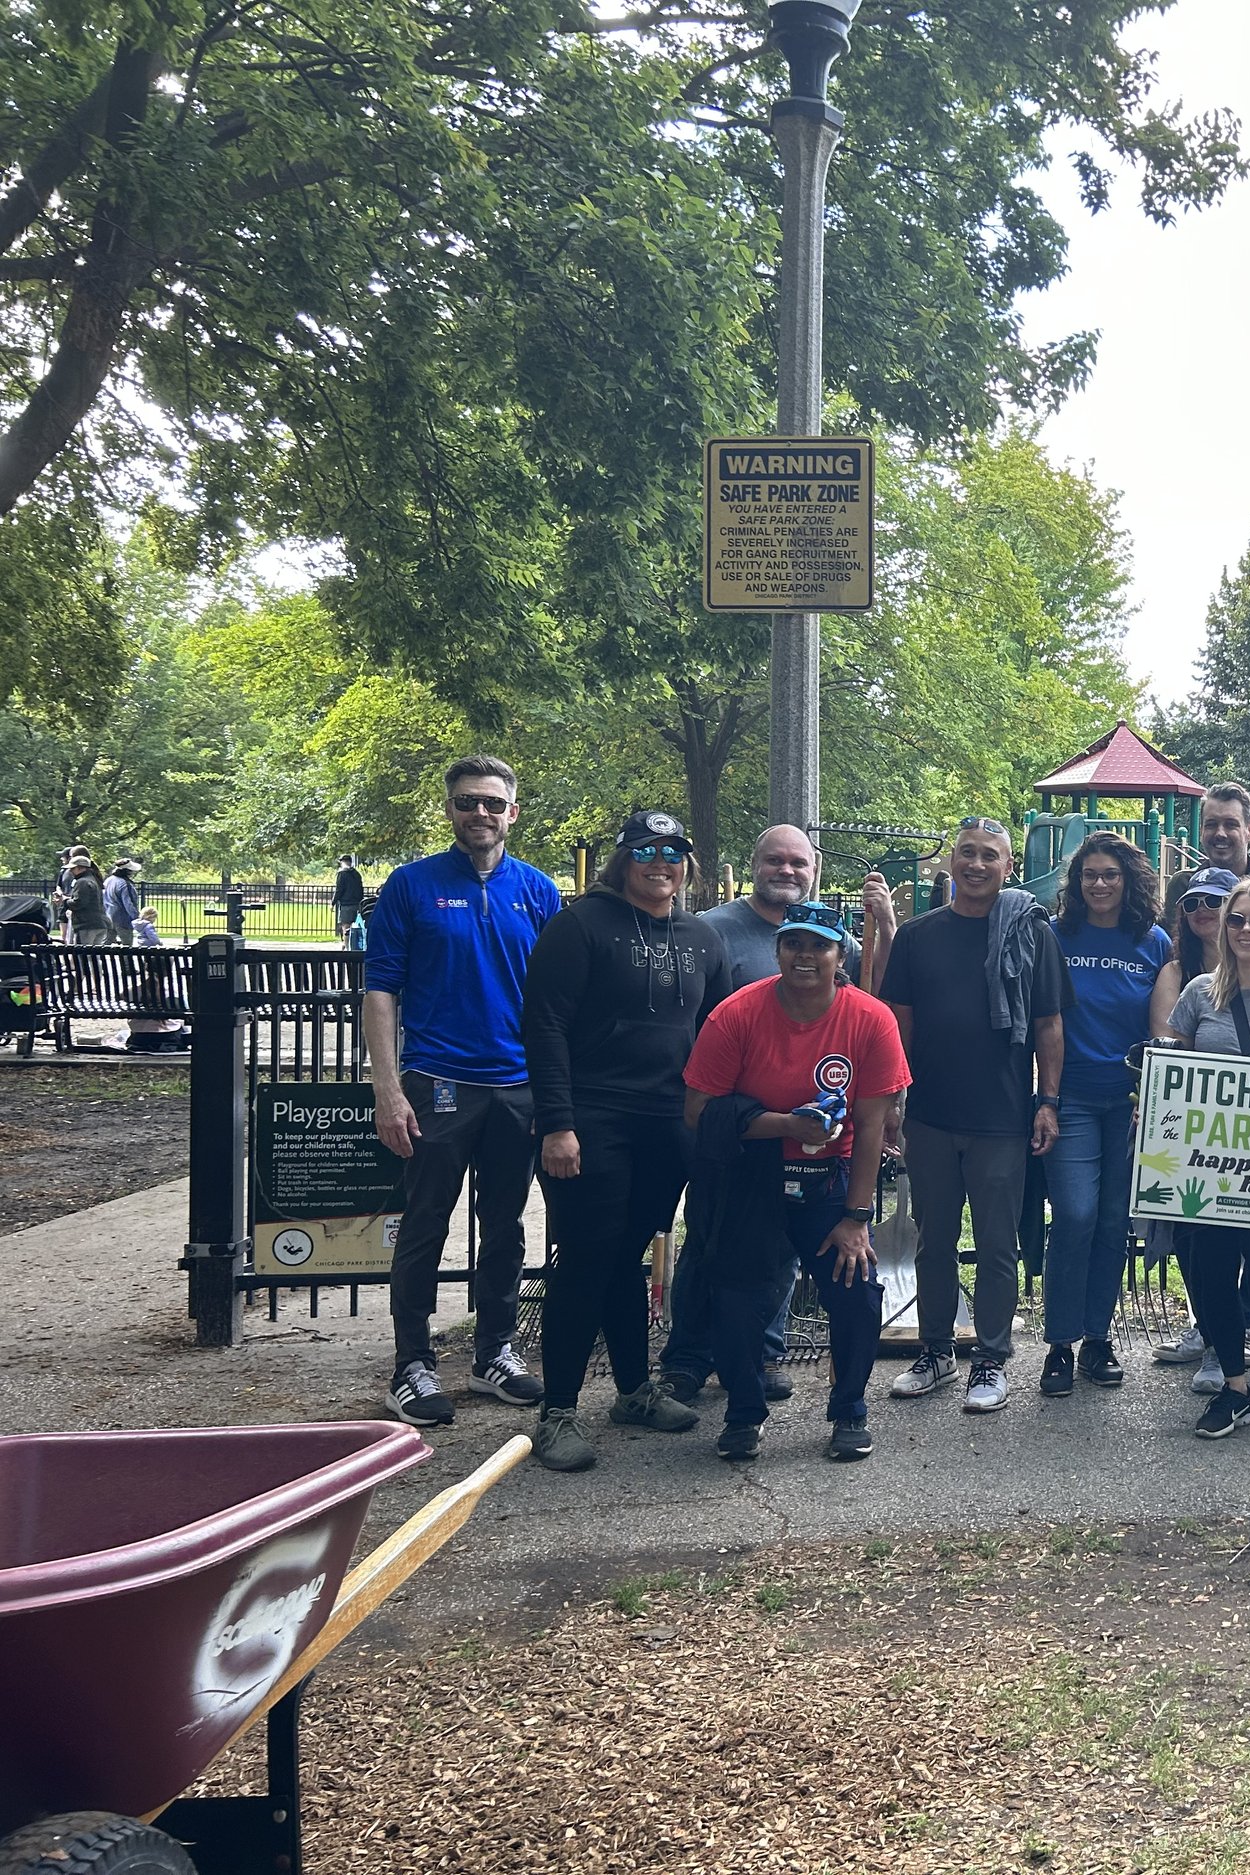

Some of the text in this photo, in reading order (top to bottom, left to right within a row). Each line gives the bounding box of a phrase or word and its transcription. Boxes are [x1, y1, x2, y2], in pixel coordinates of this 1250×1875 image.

[726, 455, 854, 475] WARNING
[720, 484, 860, 502] SAFE PARK ZONE
[728, 505, 847, 515] YOU HAVE ENTERED A
[738, 516, 767, 525] SAFE
[769, 516, 800, 525] PARK
[720, 527, 858, 536] CRIMINAL PENALTIES ARE
[727, 539, 849, 548] SEVERELY INCREASED
[721, 550, 858, 559] FOR GANG RECRUITMENT
[714, 561, 864, 572] ACTIVITY AND POSSESSION,
[721, 572, 852, 582] USE OR SALE OF DRUGS
[744, 583, 828, 593] AND WEAPONS.
[1064, 956, 1147, 974] RONT OFFICE.
[273, 1100, 376, 1129] Playgroun
[1160, 1110, 1182, 1125] for
[285, 1133, 303, 1141] keep
[320, 1132, 364, 1141] playground
[365, 1132, 380, 1140] cle
[1162, 1127, 1179, 1142] the
[304, 1141, 336, 1149] children
[337, 1141, 356, 1149] safe,
[273, 1150, 297, 1159] please
[299, 1150, 329, 1158] observe
[354, 1149, 376, 1157] rules:
